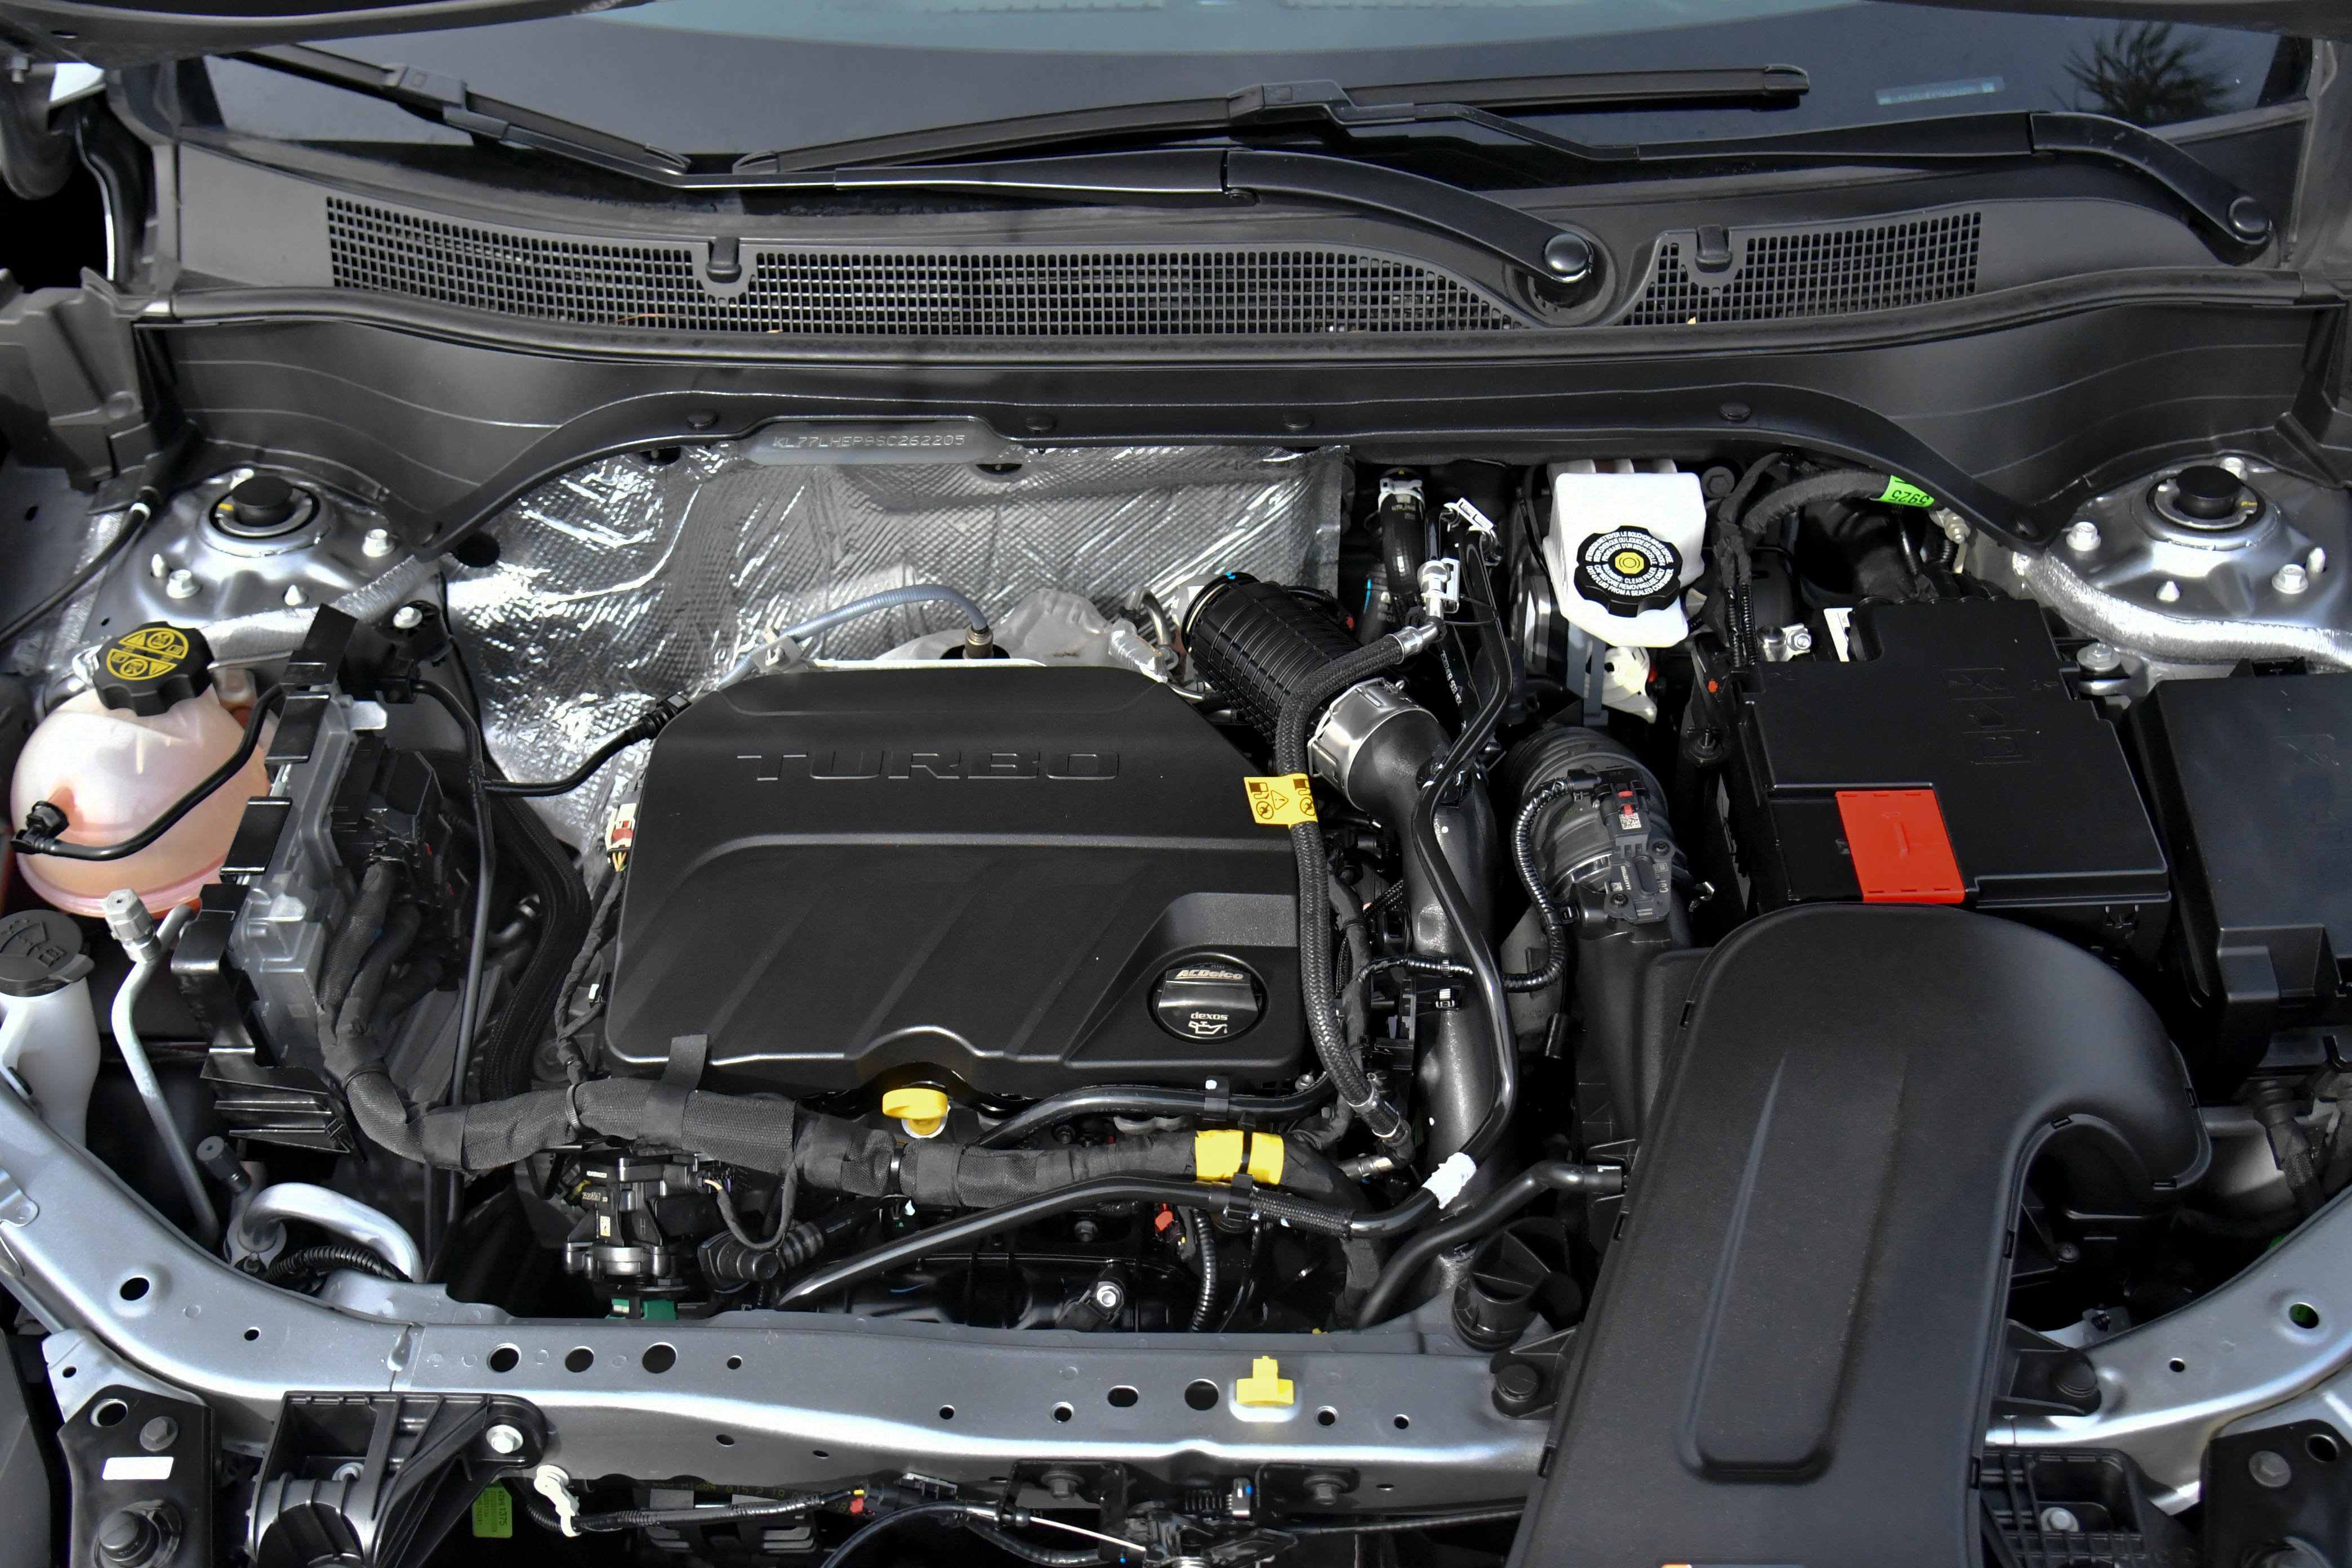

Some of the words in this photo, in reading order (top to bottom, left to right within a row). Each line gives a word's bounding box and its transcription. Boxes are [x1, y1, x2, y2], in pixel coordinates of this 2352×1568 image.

[1608, 585, 1625, 595] FROM
[1631, 587, 1654, 596] SEALED
[736, 750, 1119, 781] TURBO
[1175, 969, 1244, 980] ACDelco
[1190, 1012, 1229, 1021] dexos
